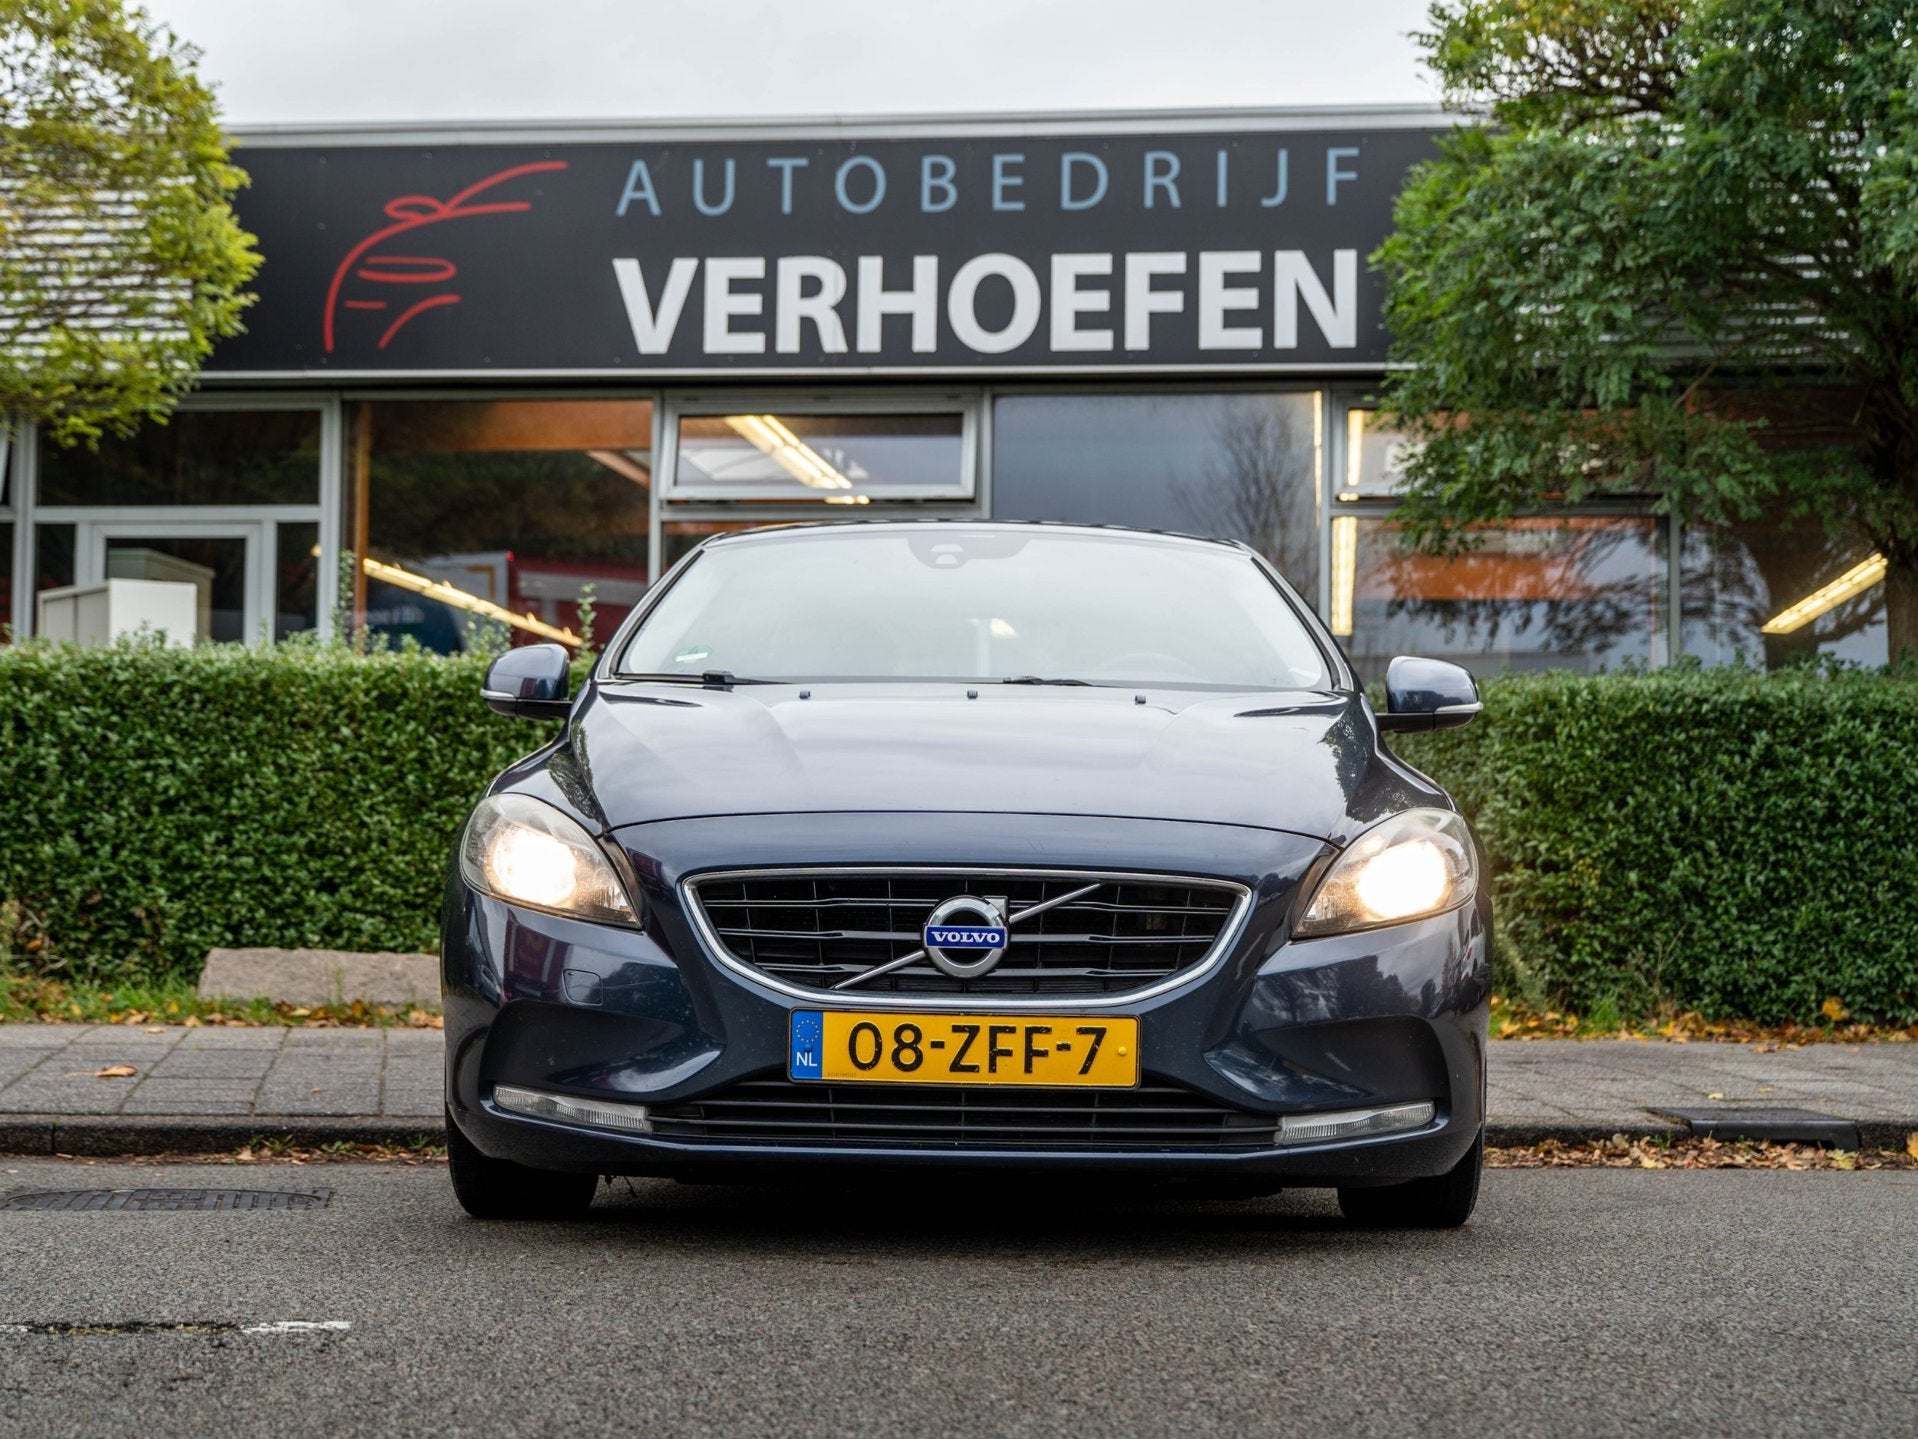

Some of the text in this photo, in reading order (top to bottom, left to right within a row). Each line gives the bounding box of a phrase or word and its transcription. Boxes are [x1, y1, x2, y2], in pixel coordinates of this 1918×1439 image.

[615, 146, 1360, 217] AUTOBEDRIJF
[612, 248, 1359, 355] VERHOEFEN
[931, 931, 1001, 944] VOLVO
[796, 1051, 818, 1067] NL
[848, 1021, 1107, 1075] 08-ZFF-7
